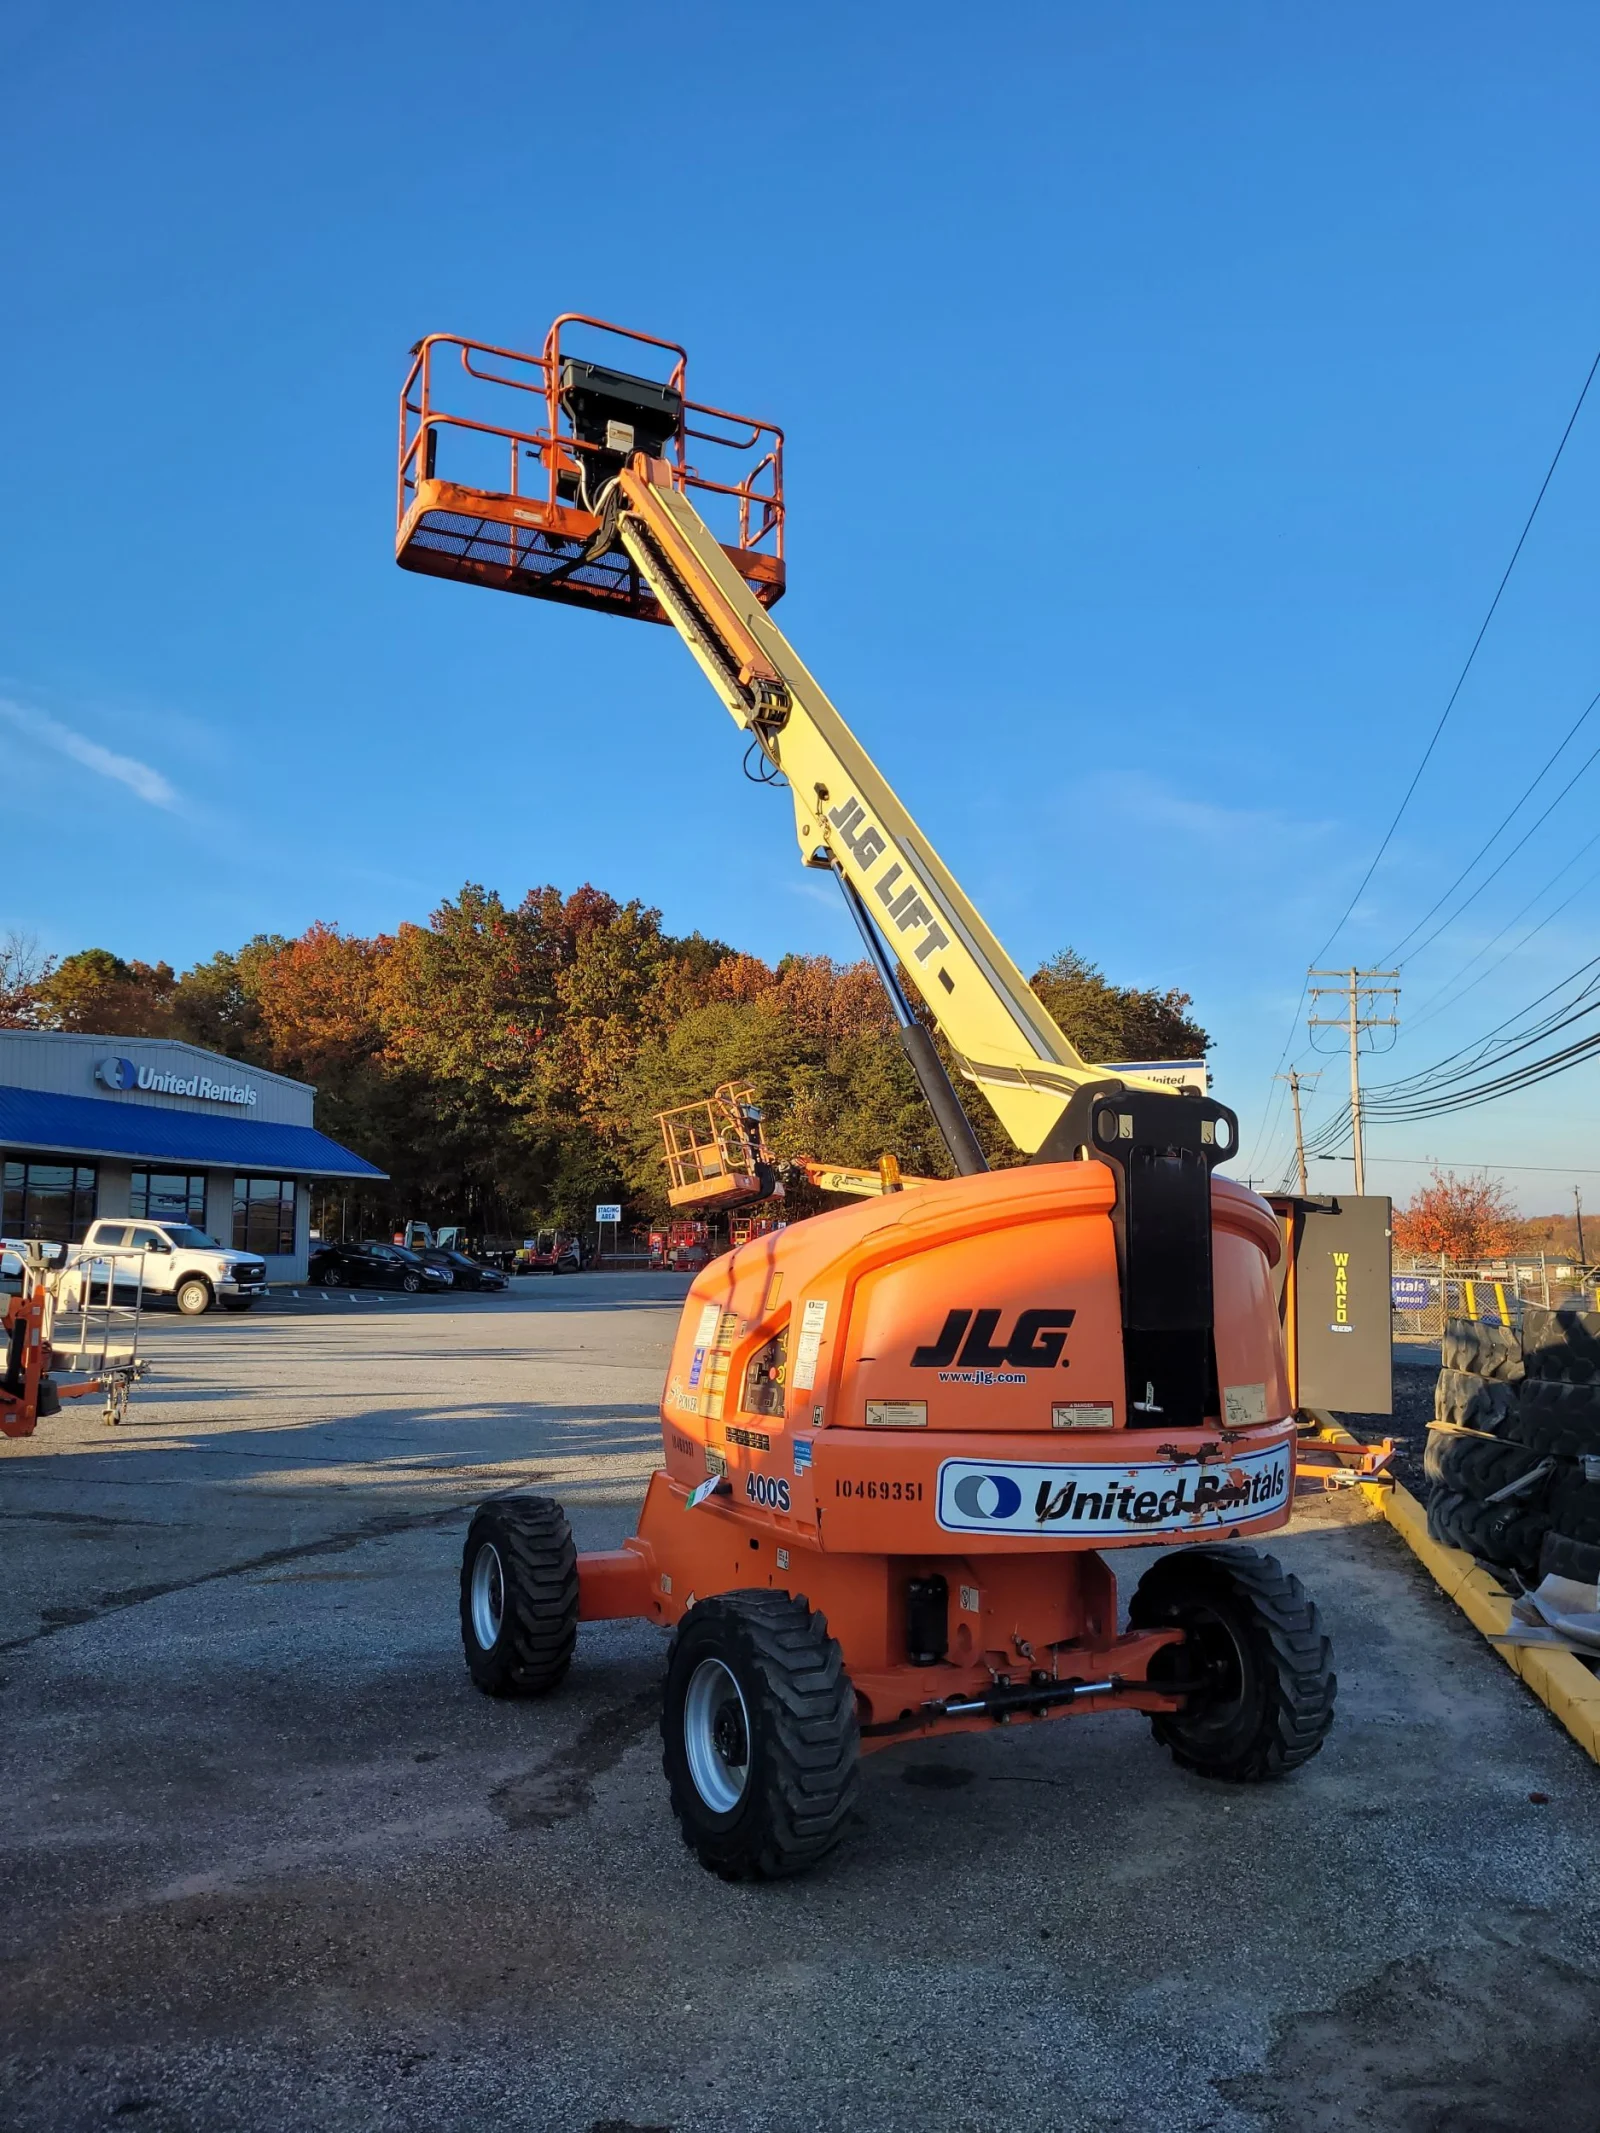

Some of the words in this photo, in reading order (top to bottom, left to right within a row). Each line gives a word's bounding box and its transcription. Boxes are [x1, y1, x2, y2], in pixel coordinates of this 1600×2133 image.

[828, 796, 887, 872] JLG
[874, 862, 950, 963] LIFT
[138, 1066, 199, 1096] United
[198, 1077, 257, 1106] Rentals
[1333, 1253, 1349, 1323] WANCO
[938, 1370, 1026, 1385] www.jlg.com
[746, 1471, 791, 1512] 400S
[835, 1479, 922, 1501] 10469351
[1035, 1477, 1188, 1521] United
